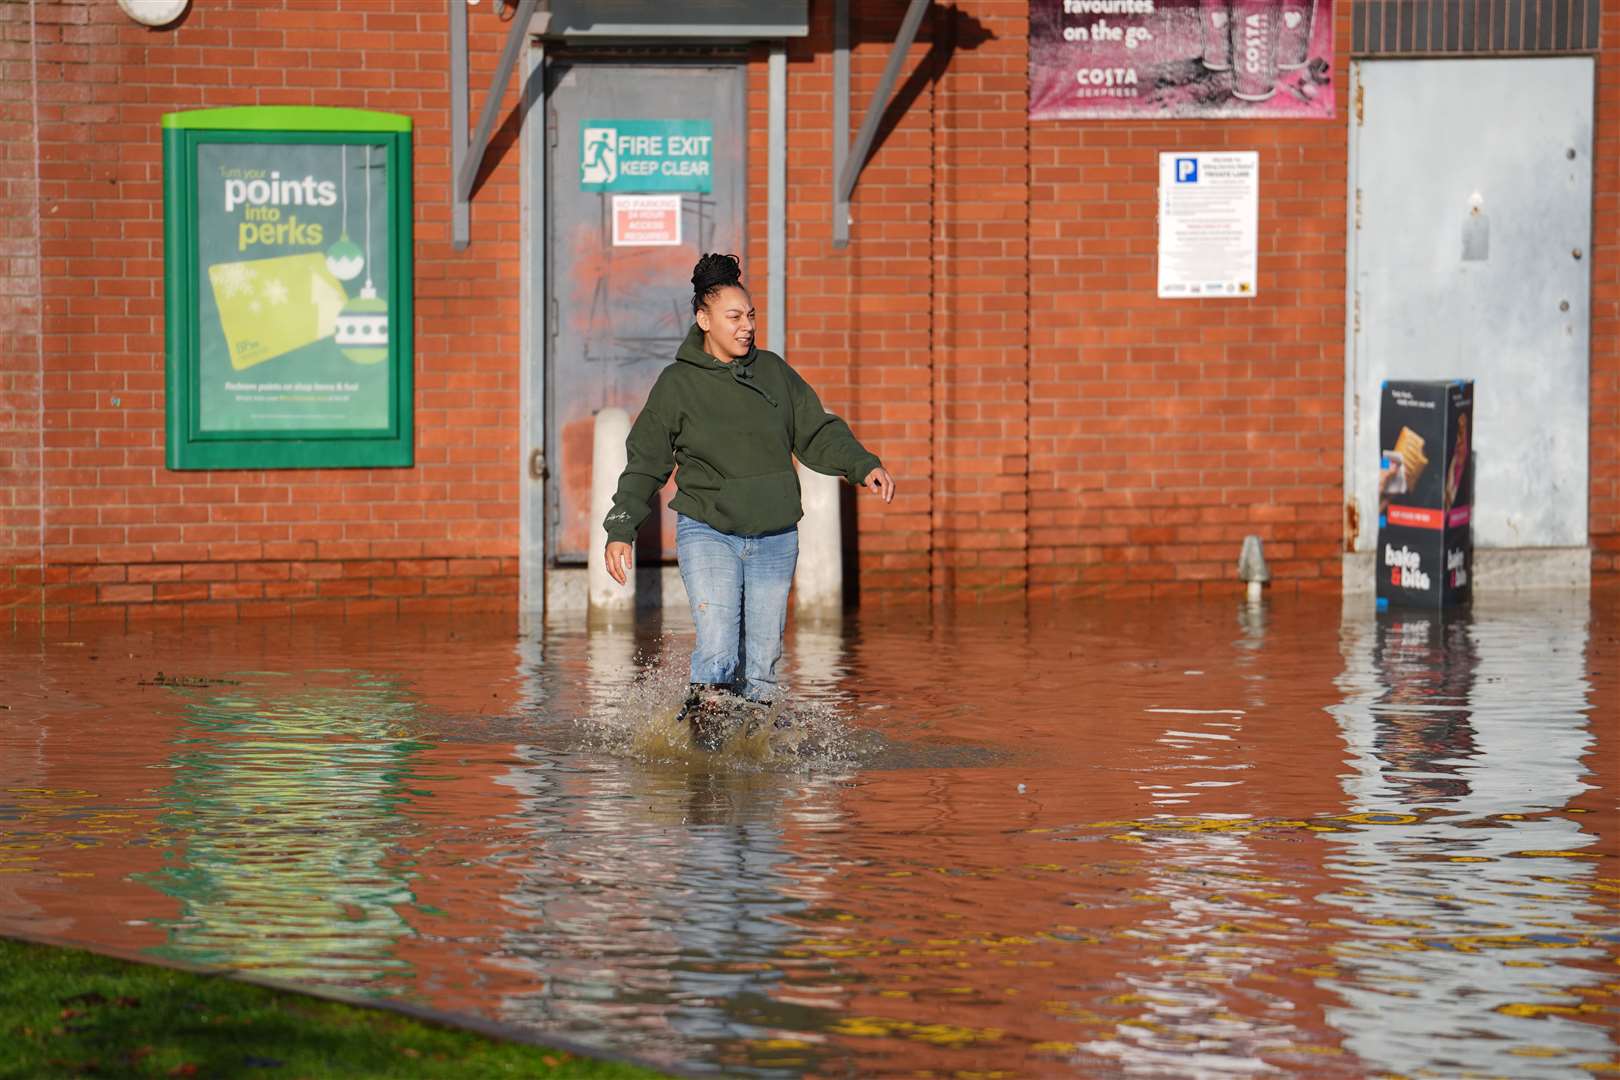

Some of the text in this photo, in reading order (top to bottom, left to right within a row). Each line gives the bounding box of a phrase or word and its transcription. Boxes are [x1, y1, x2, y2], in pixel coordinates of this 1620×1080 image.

[1064, 0, 1154, 14] favourites
[1064, 19, 1153, 49] on the go.
[1246, 13, 1260, 73] COSTA
[1077, 68, 1138, 87] COSTA
[619, 135, 712, 156] FIRE EXIT
[621, 161, 709, 176] KEEP CLEAR
[225, 171, 337, 212] points
[245, 203, 280, 221] into
[239, 215, 323, 252] perks
[1385, 543, 1420, 569] bake
